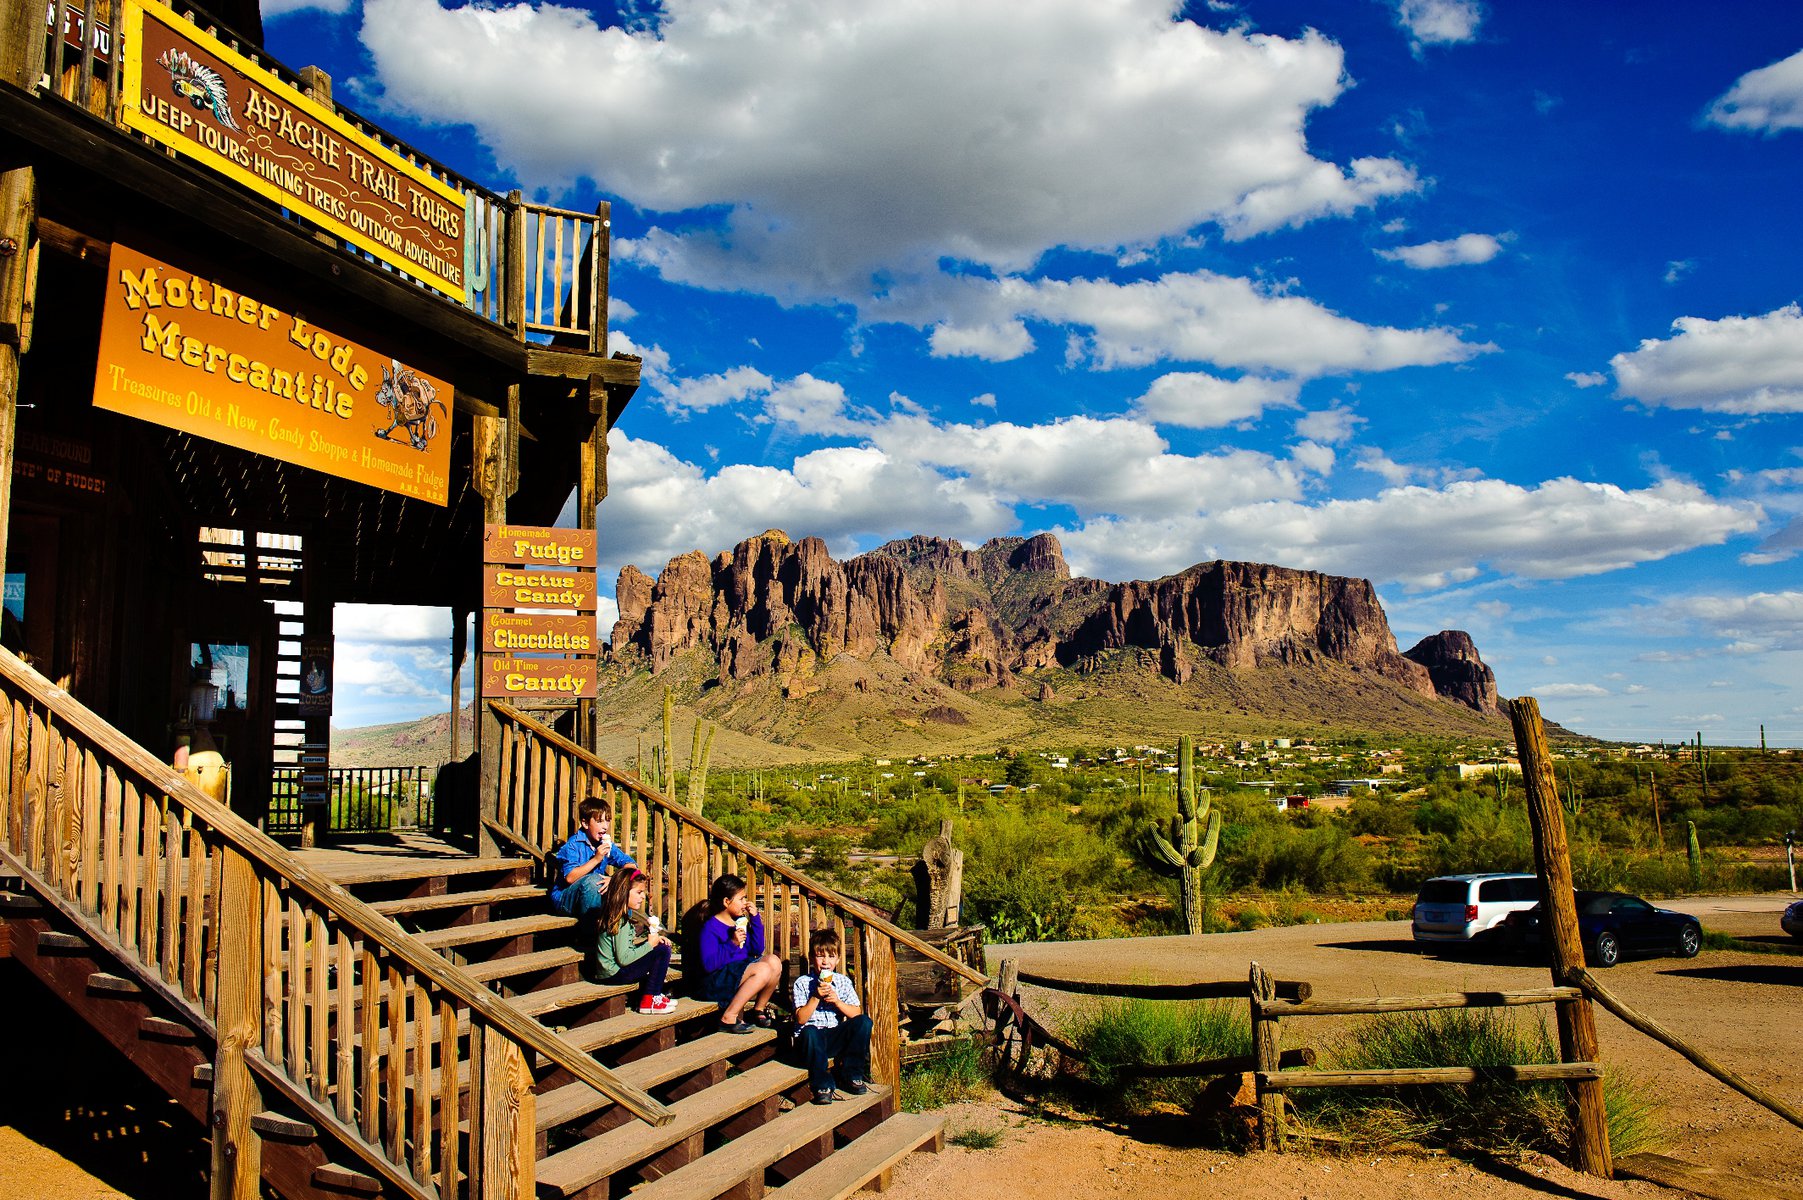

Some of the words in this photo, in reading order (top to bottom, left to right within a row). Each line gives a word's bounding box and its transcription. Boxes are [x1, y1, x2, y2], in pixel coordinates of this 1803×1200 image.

[243, 88, 341, 170] APACHE
[346, 145, 406, 214] TRAIL
[407, 183, 460, 239] TOURS
[142, 93, 192, 133] JEEP
[195, 118, 249, 167] TOURS
[254, 150, 303, 197] HIKING
[305, 180, 347, 221] TREKS
[349, 207, 403, 253] OUTDOOR
[404, 239, 461, 286] ADVENTURE
[120, 267, 279, 332] Mother
[289, 316, 369, 393] Lode
[141, 314, 354, 420] Mercantile
[109, 363, 182, 409] Treasures
[186, 390, 210, 419] Old
[214, 407, 222, 420] &
[269, 417, 305, 450] Candy
[308, 431, 348, 462] Shoppe
[351, 449, 358, 462] &
[361, 448, 413, 481] Homemade
[416, 465, 444, 490] Fudge
[50, 438, 92, 464] ROUND
[47, 468, 61, 483] OF
[64, 472, 106, 493] FUDGE!
[499, 527, 551, 539] Homemade
[513, 540, 584, 565] Fudge
[496, 572, 575, 588] Cactus
[514, 589, 586, 607] Candy
[491, 614, 532, 626] Gourmet
[493, 629, 590, 650] Chocolates
[493, 659, 510, 671] Old
[513, 659, 539, 671] Time
[505, 673, 587, 696] Candy
